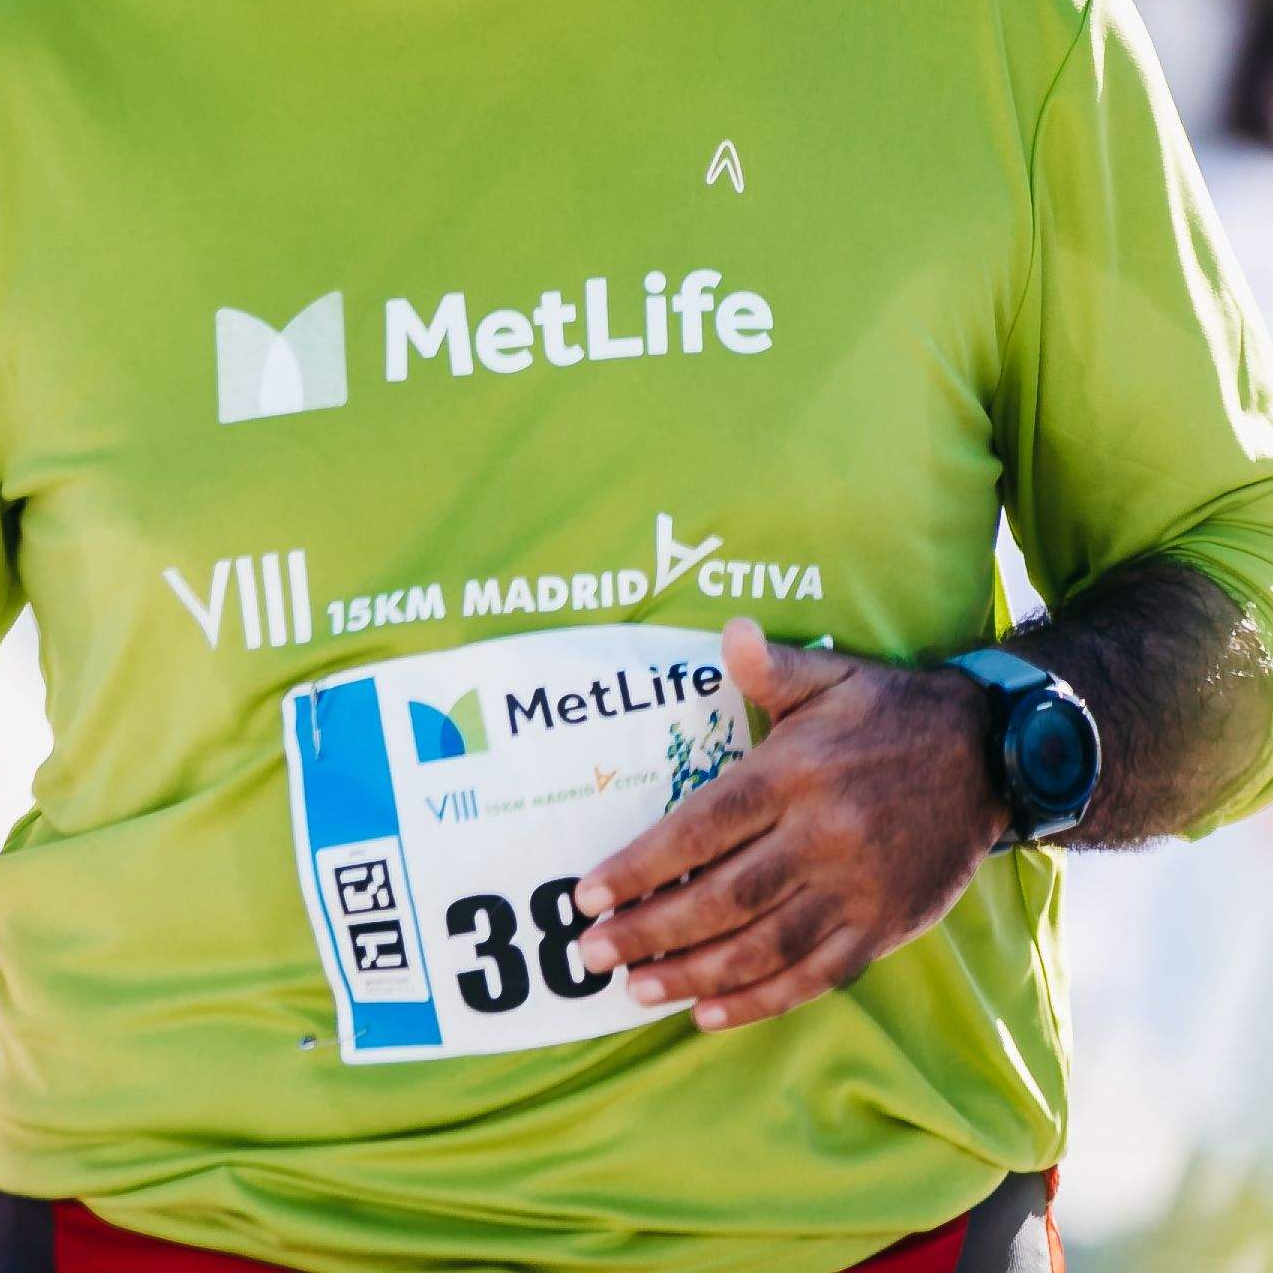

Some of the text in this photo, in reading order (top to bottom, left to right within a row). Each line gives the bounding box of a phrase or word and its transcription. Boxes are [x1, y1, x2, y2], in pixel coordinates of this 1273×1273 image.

[385, 269, 774, 382] MetLife
[163, 549, 313, 650] VIII
[328, 584, 446, 635] 15KM
[462, 573, 649, 616] MADRID
[505, 662, 723, 736] MetLife
[425, 787, 479, 823] VIII
